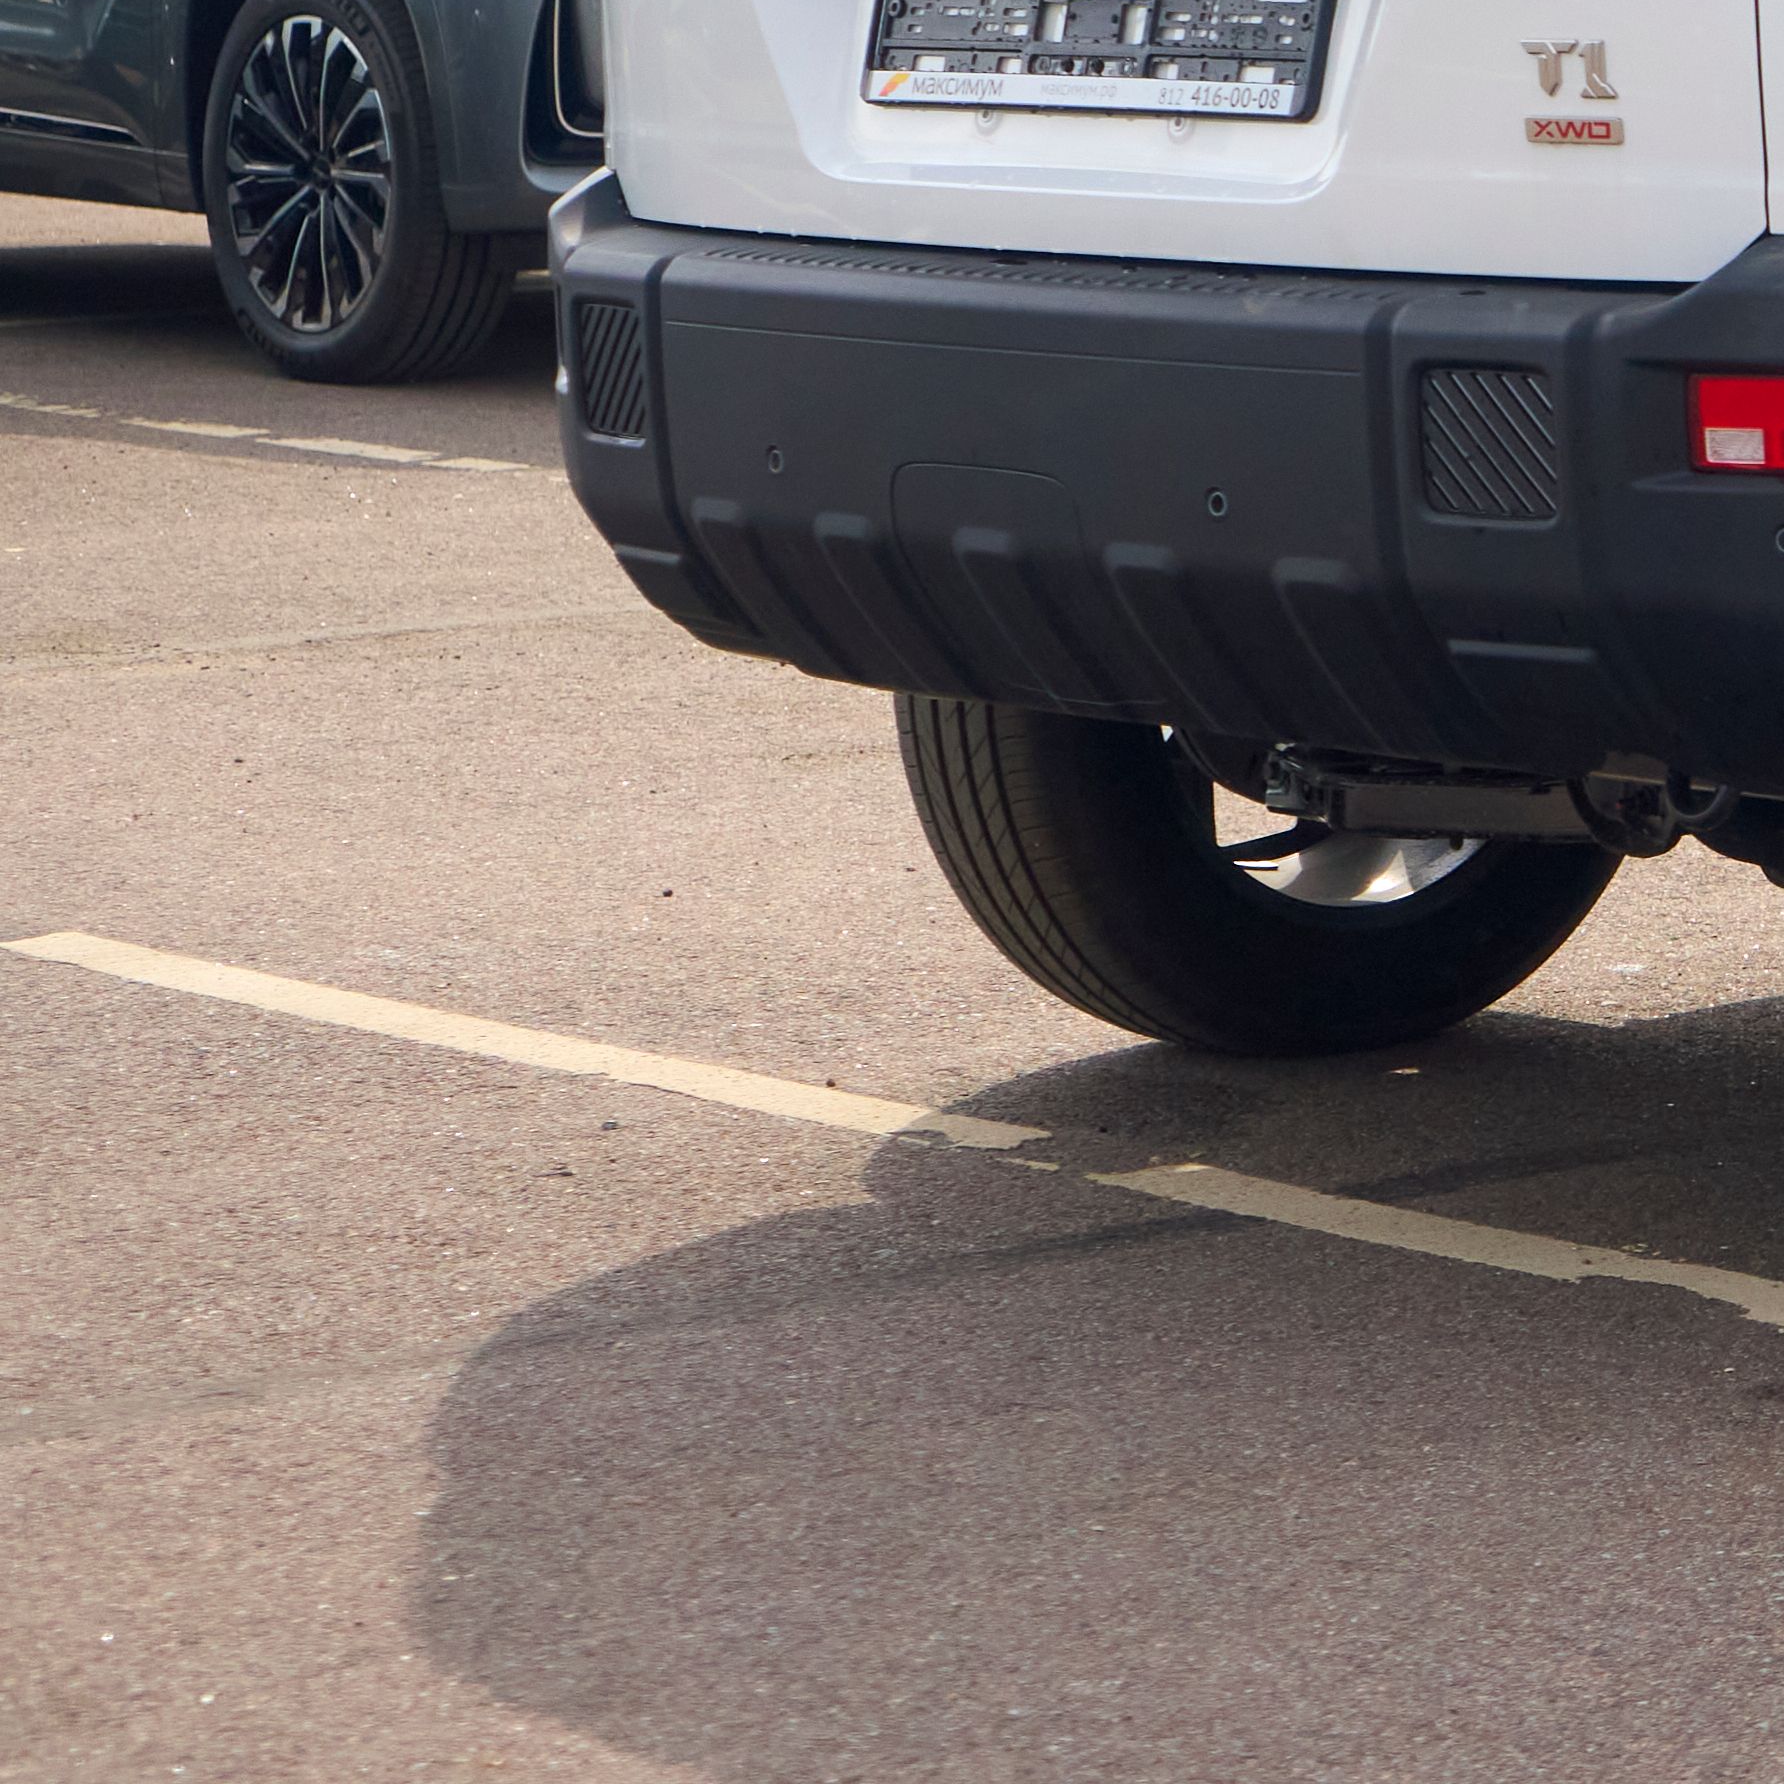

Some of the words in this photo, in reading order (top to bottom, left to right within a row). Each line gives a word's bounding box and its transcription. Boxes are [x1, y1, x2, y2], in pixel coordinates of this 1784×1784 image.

[1520, 39, 1619, 99] T1
[911, 76, 1003, 100] максимум
[1158, 87, 1183, 106] 812
[1190, 85, 1281, 109] 416-00-08
[1533, 120, 1612, 140] XWD
